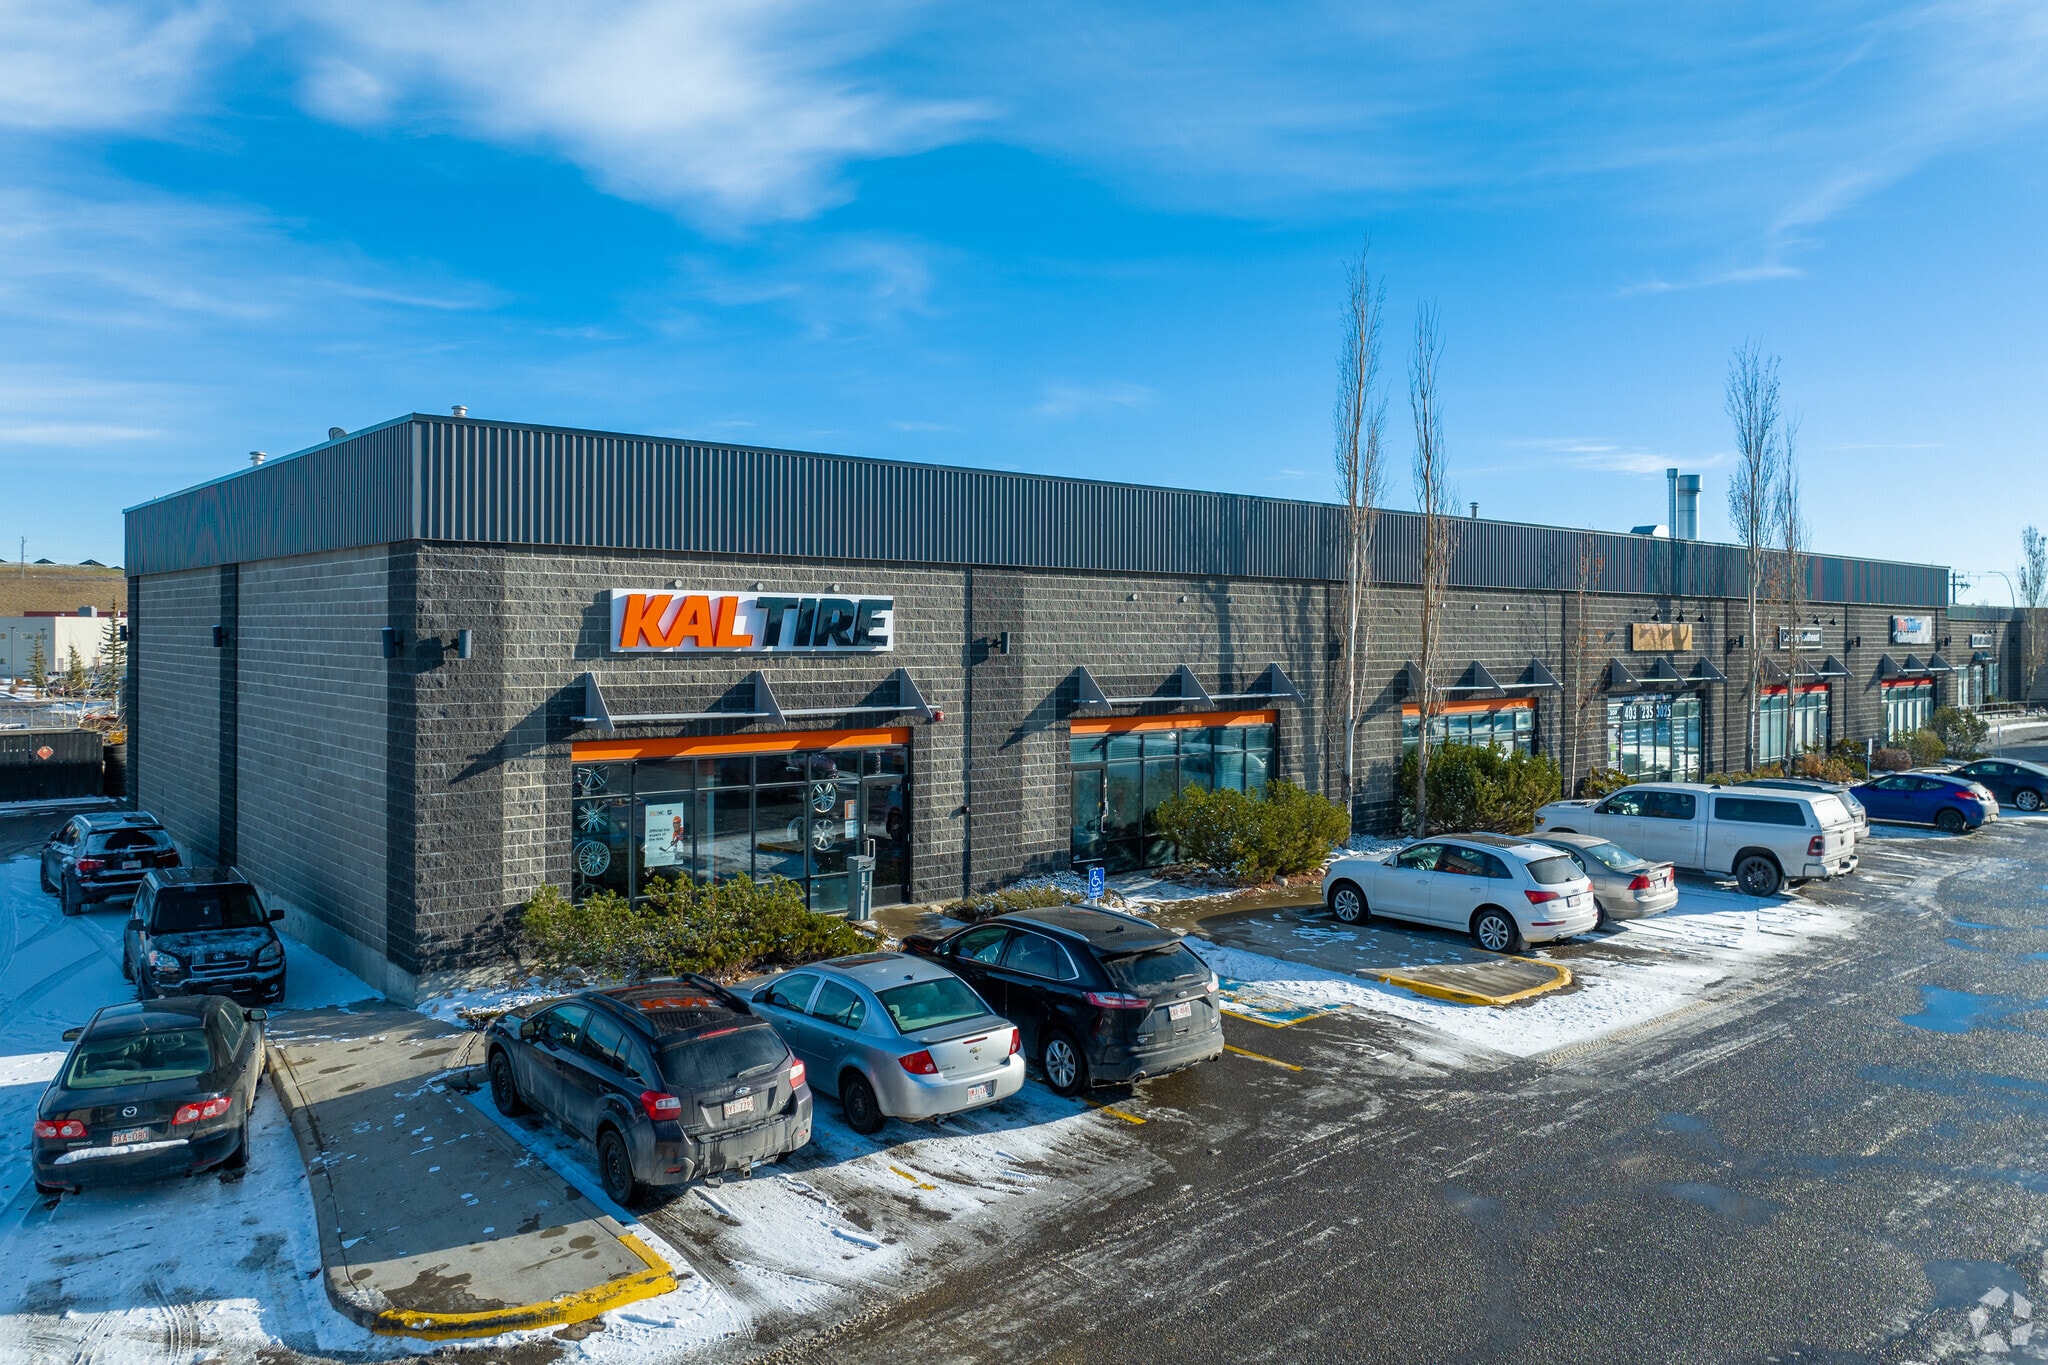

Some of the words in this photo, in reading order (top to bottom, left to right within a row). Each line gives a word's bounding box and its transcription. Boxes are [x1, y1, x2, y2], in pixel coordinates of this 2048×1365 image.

[619, 594, 753, 647] KAL
[756, 596, 893, 647] TIRE
[1624, 706, 1637, 720] 403
[1641, 705, 1654, 719] 235
[1656, 704, 1671, 718] 3025
